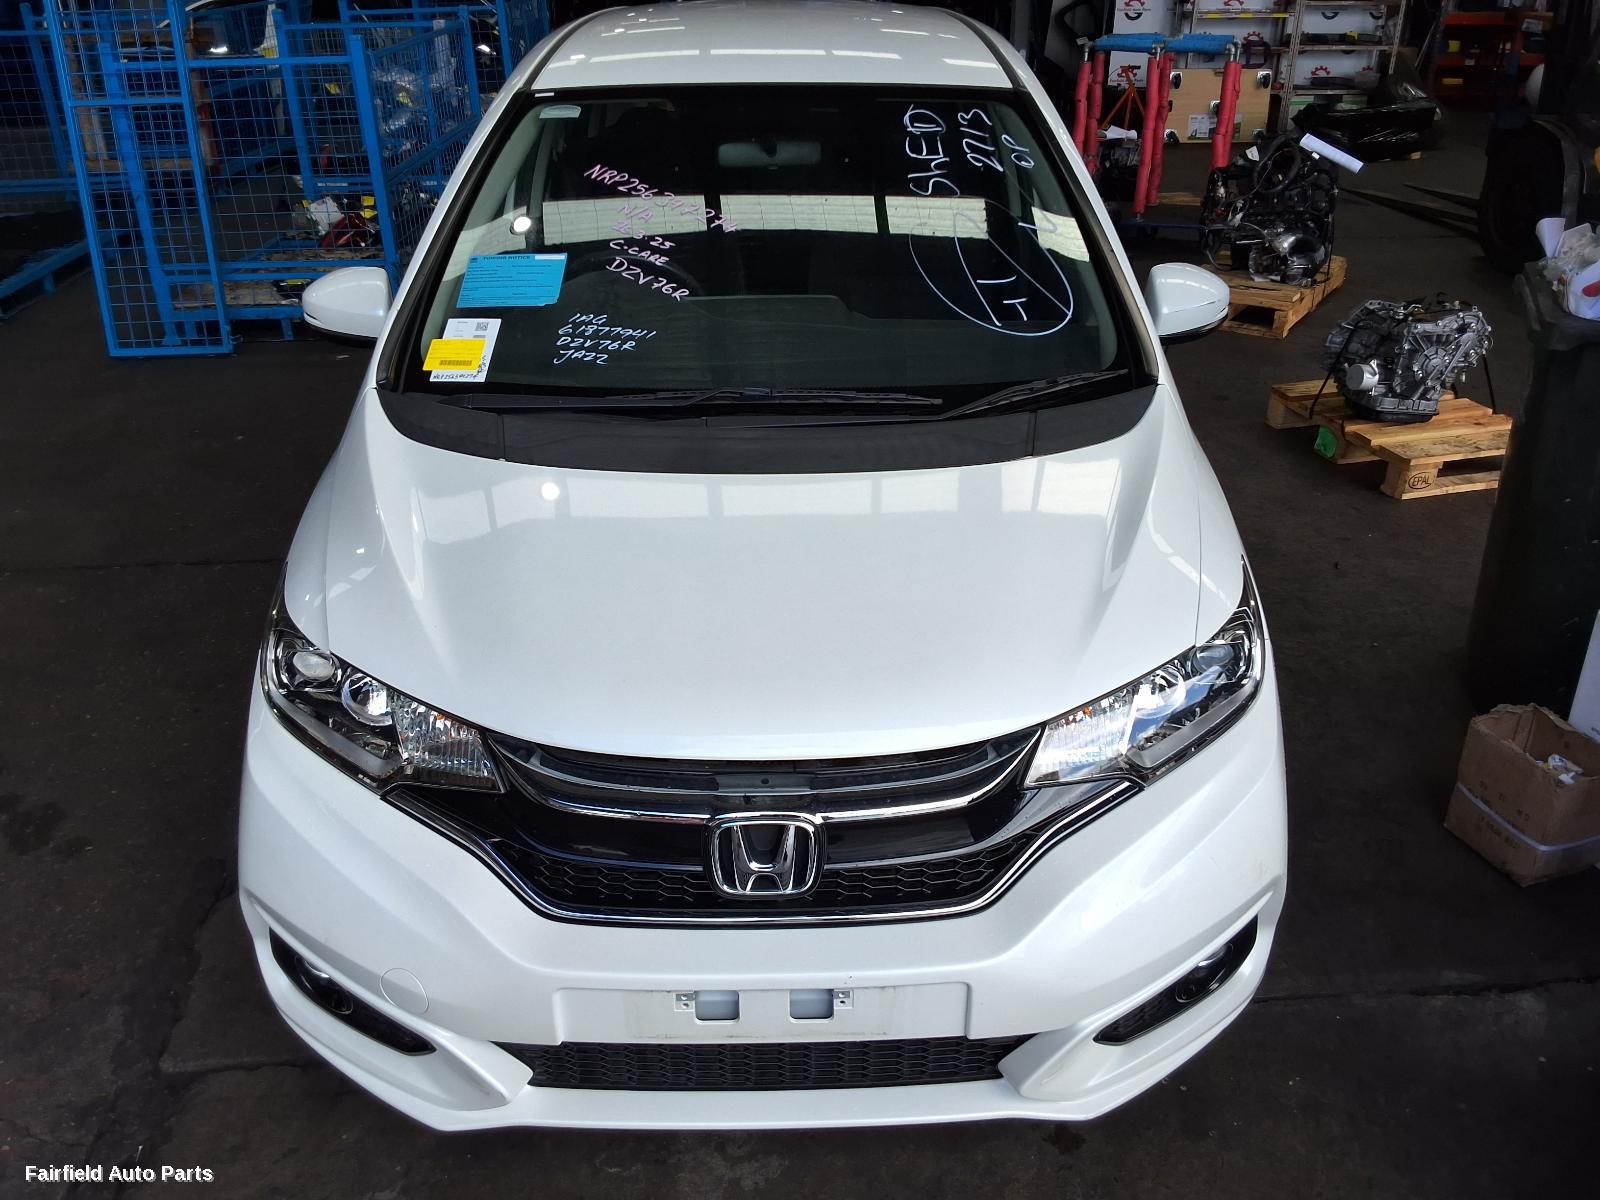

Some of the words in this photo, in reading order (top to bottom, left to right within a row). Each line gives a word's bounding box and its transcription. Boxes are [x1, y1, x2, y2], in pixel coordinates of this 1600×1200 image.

[958, 108, 1004, 172] 2713
[553, 349, 609, 365] JAZZ
[1411, 475, 1431, 487] EPAL
